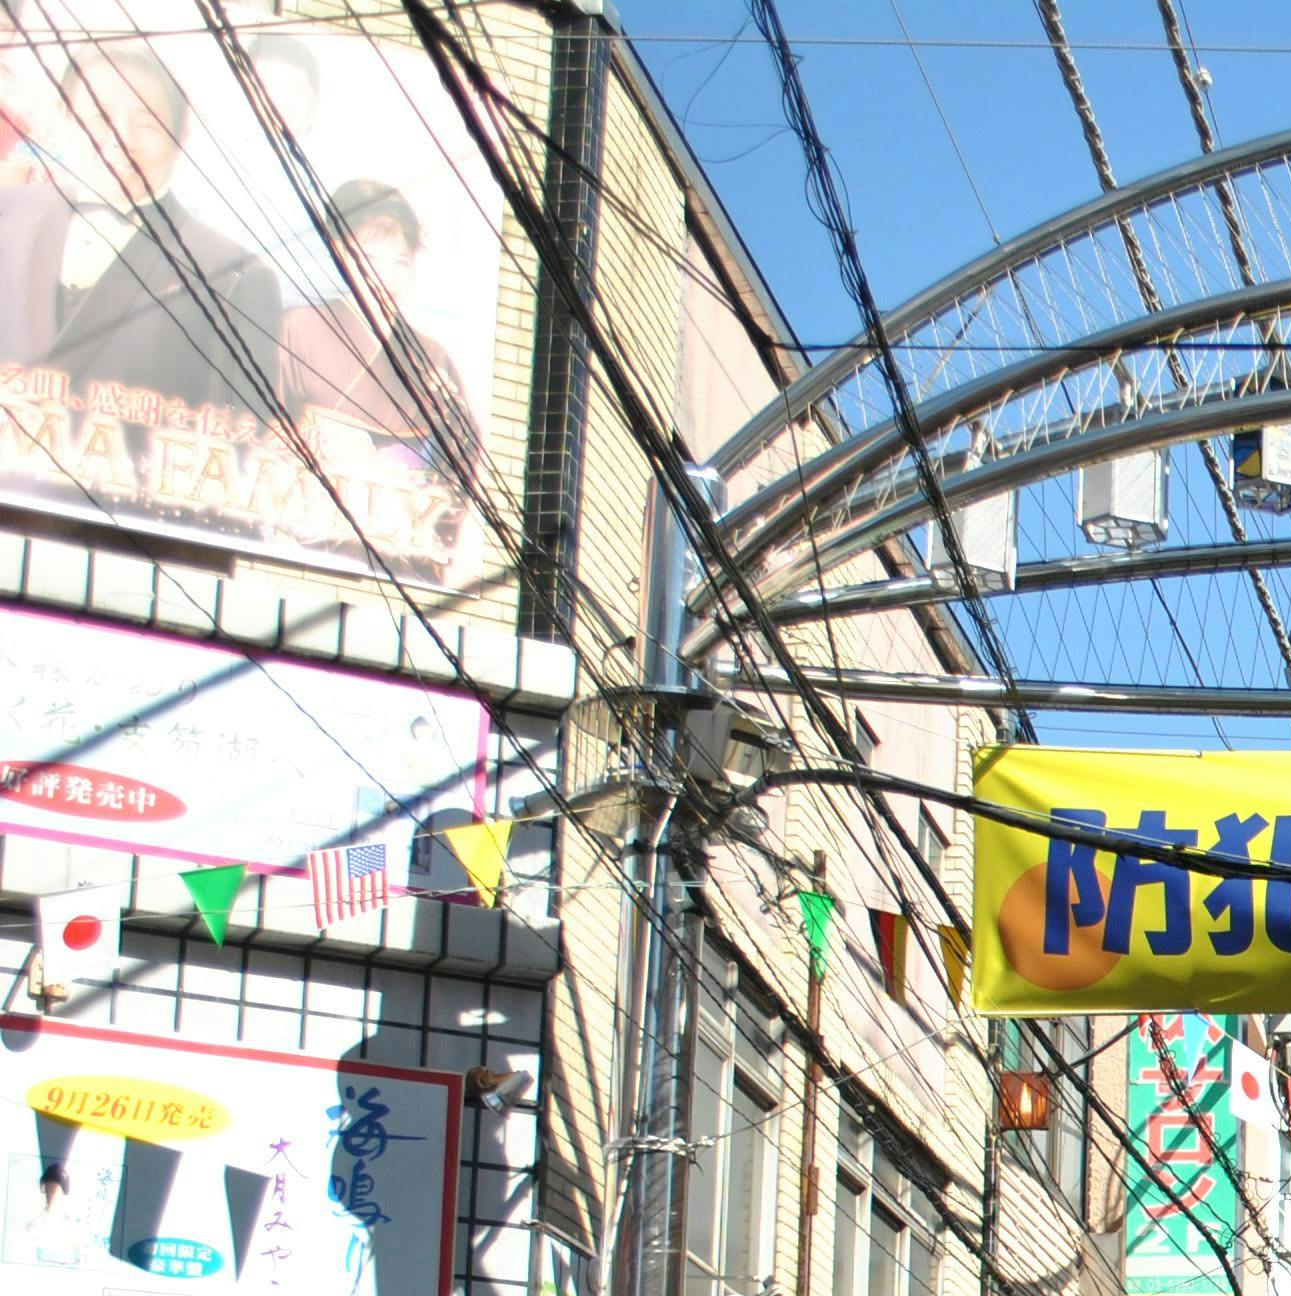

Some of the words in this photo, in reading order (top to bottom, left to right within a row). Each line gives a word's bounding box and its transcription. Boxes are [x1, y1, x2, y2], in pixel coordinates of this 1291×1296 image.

[156, 434, 450, 550] FAMILY
[0, 764, 158, 816] 好評発売中
[44, 1086, 217, 1130] 9月26日発売
